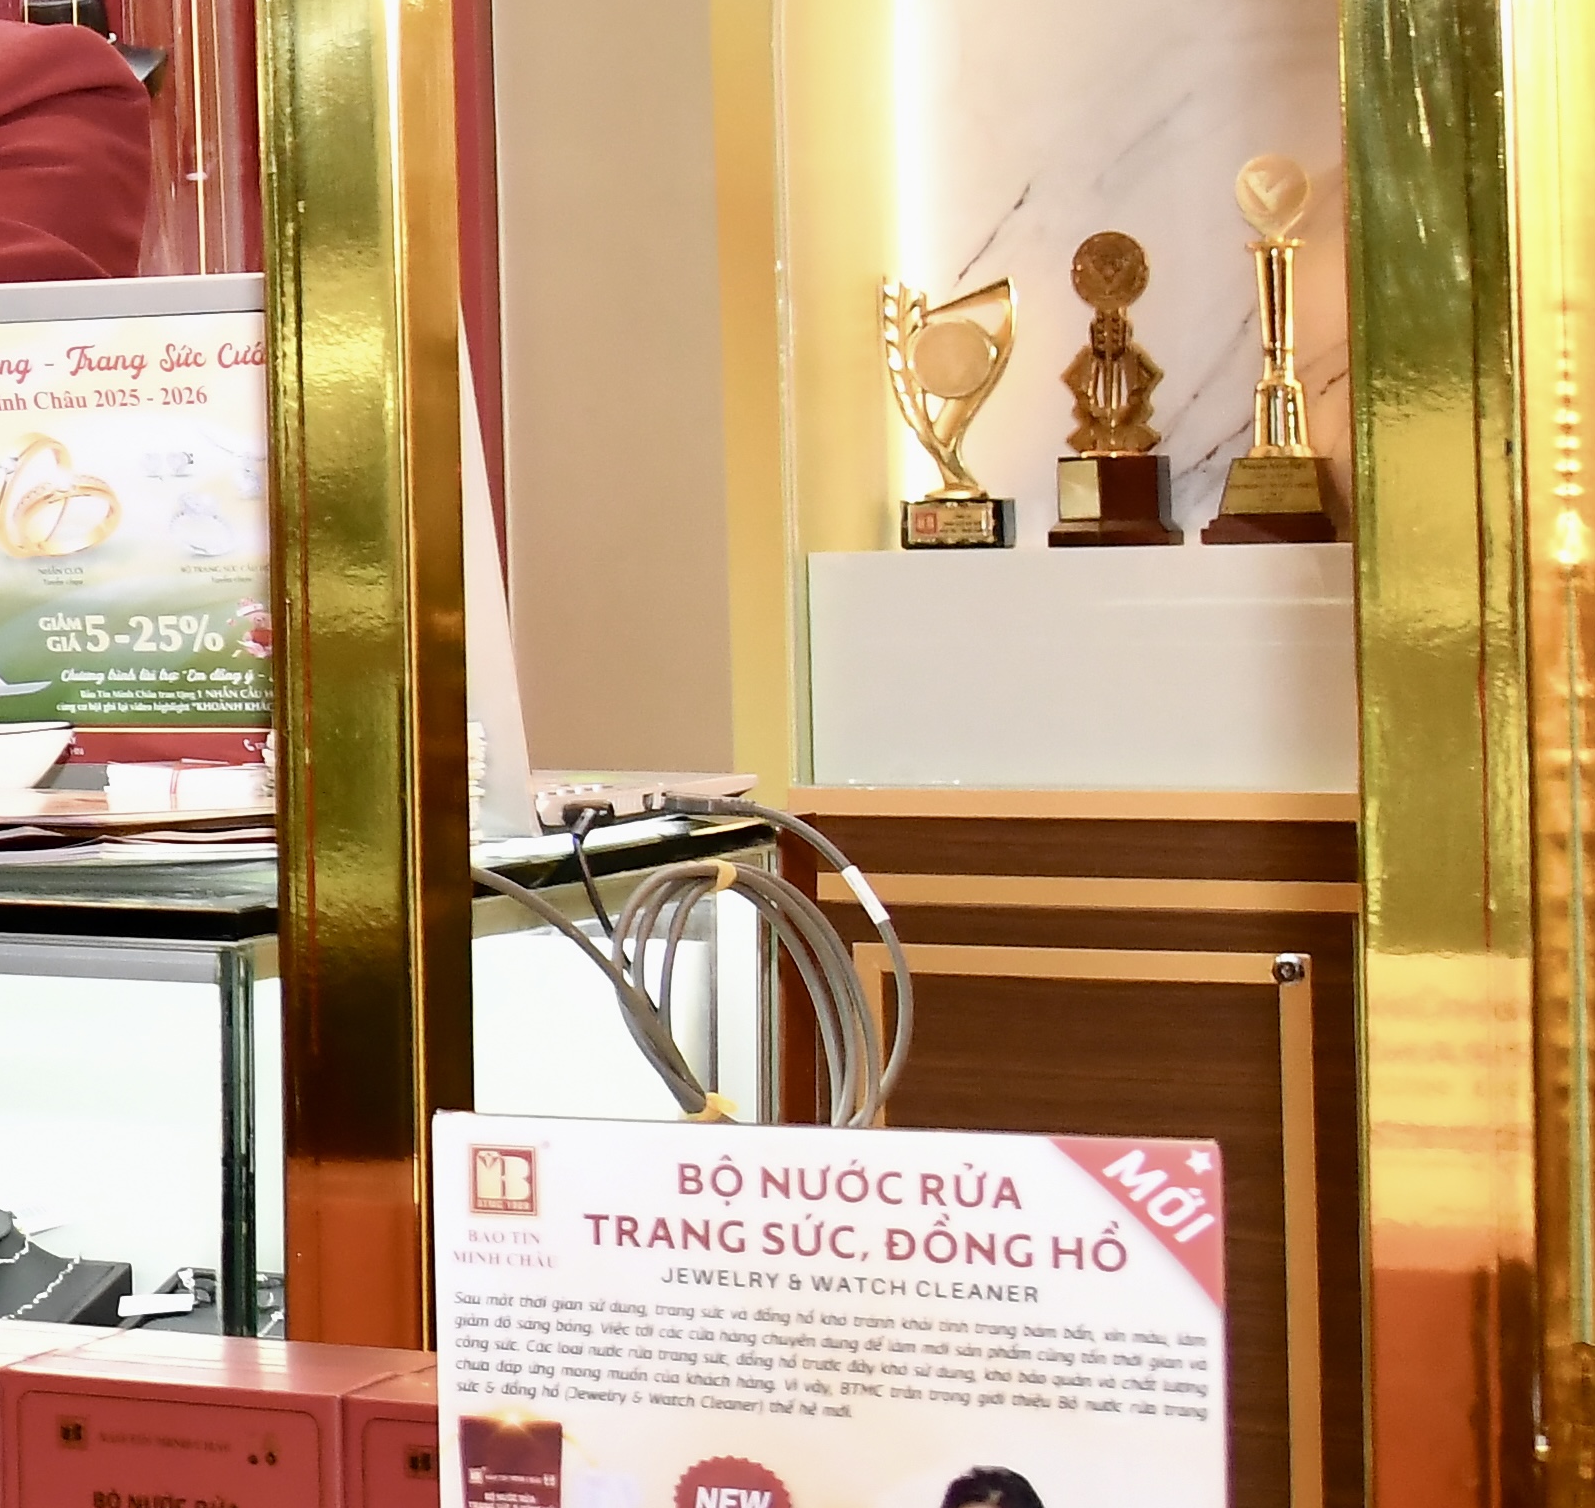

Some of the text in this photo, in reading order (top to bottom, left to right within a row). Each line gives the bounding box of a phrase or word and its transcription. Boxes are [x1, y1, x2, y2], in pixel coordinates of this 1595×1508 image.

[66, 345, 149, 382] Trang
[158, 343, 207, 371] Sức
[217, 340, 267, 370] Cướ
[33, 389, 88, 411] Châu
[94, 388, 142, 409] 2025
[160, 386, 209, 407] 2026
[38, 612, 225, 653] GIẢM 5-25%
[46, 635, 82, 652] GIÁ
[676, 1154, 1023, 1211] BỘ NƯỚC RỬA
[1102, 1148, 1215, 1244] MỚI
[583, 1213, 1128, 1274] TRANG SỨC, ĐỒNG HỒ
[661, 1267, 1039, 1304] JEWELRY & WATCH CLEANER
